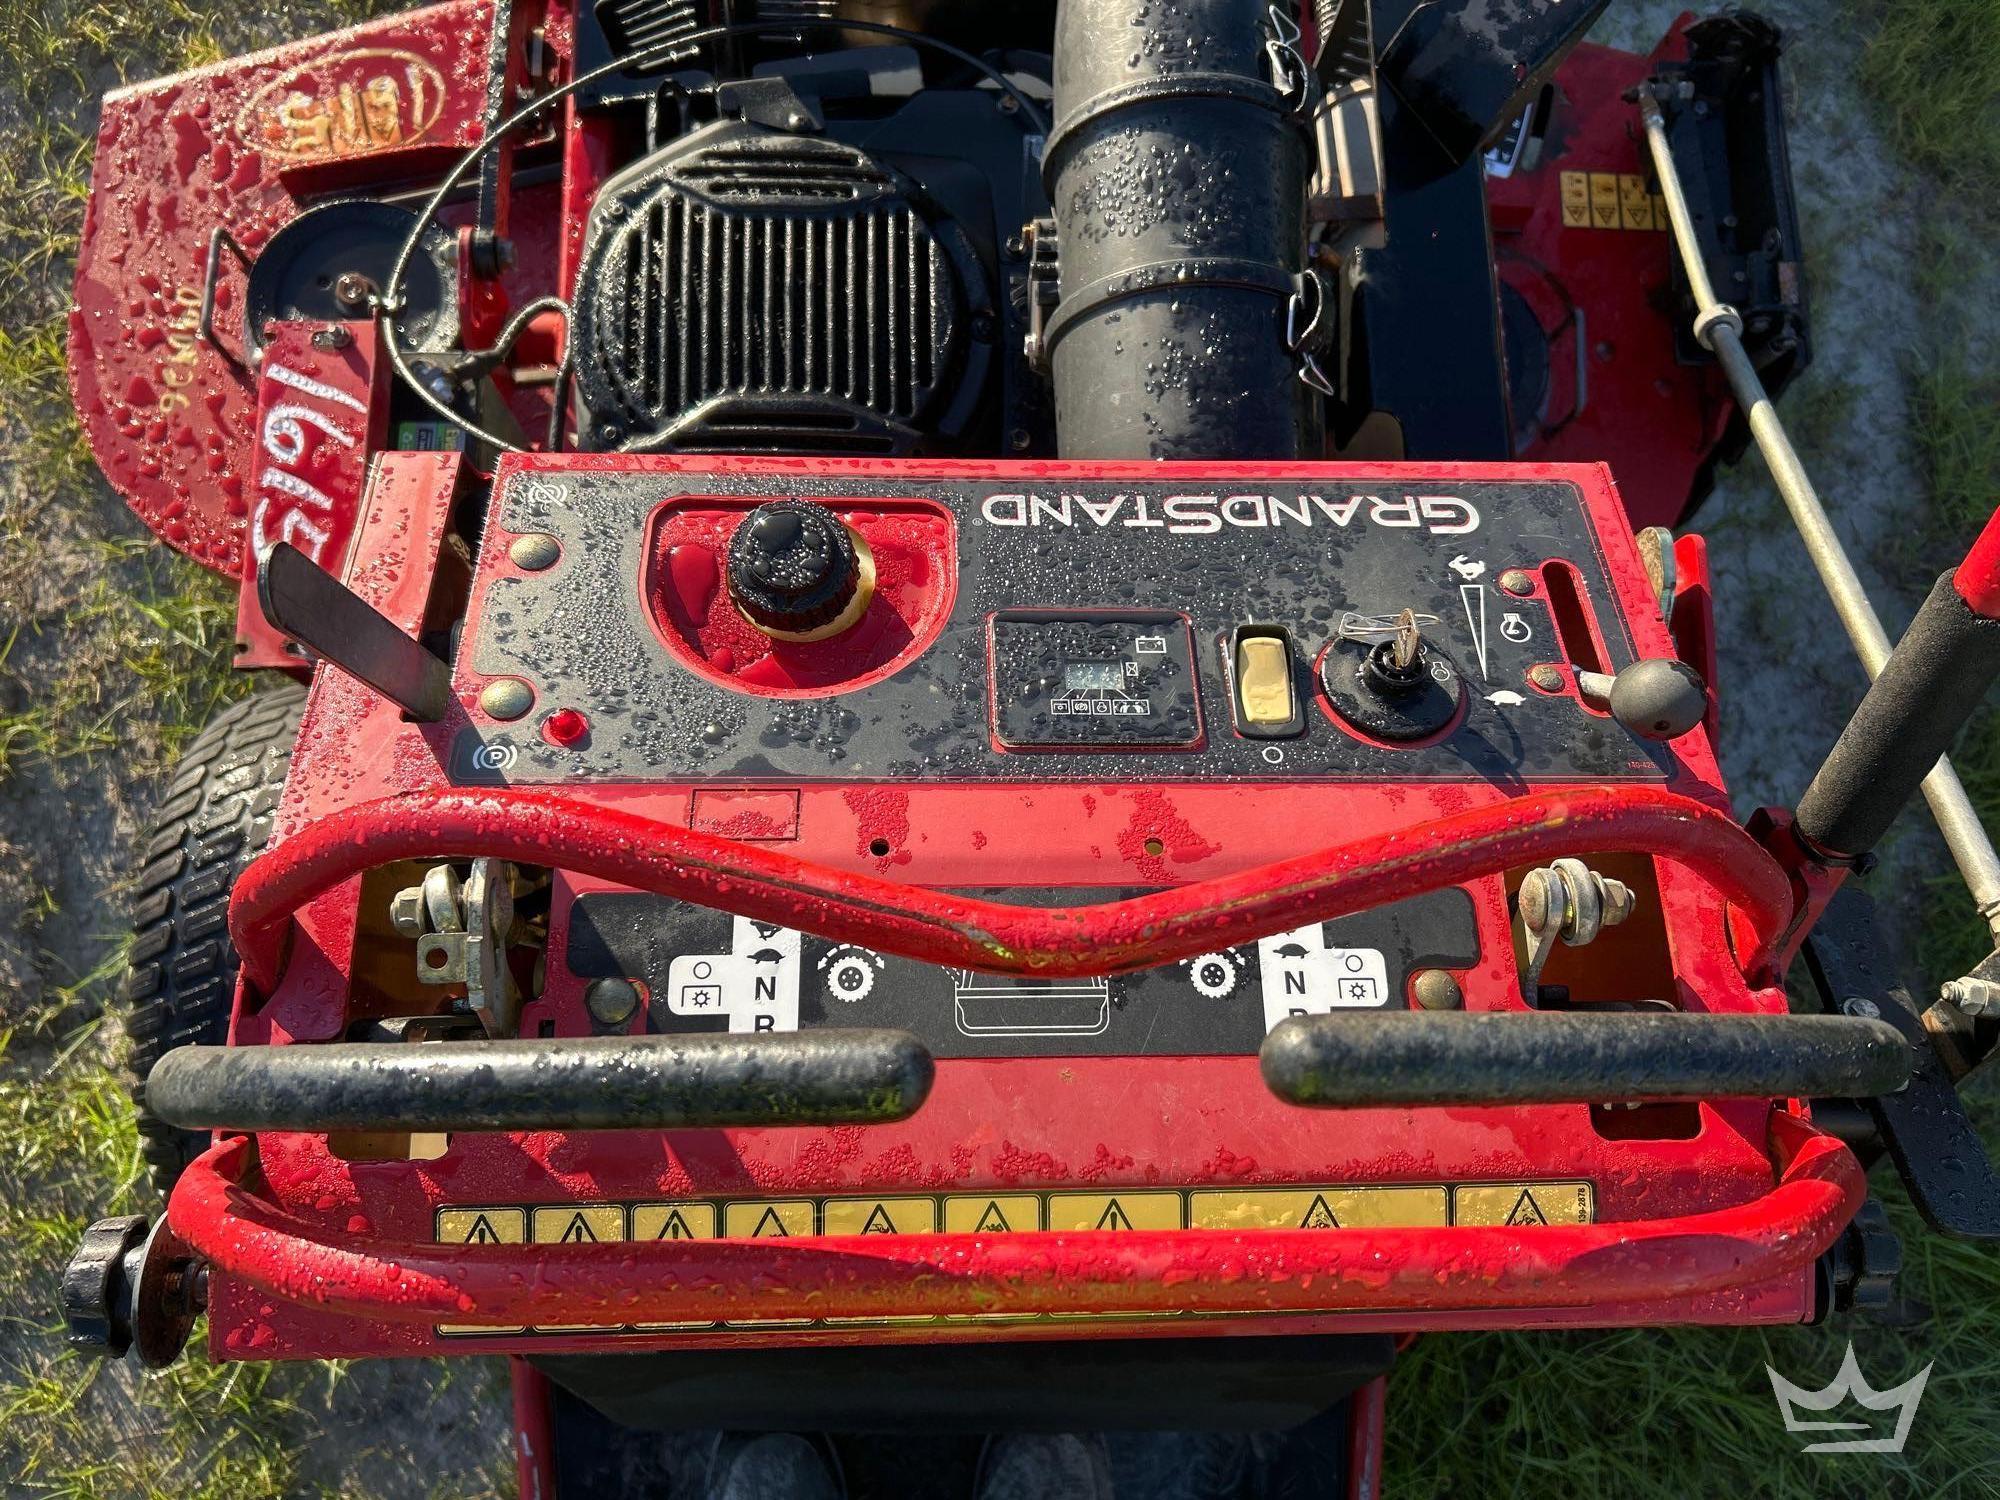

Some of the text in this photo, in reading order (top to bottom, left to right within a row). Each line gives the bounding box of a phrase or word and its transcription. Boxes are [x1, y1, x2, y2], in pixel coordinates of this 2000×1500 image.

[754, 976, 776, 1001] N
[1284, 970, 1306, 995] N
[1577, 1187, 1586, 1223] 139-2878
